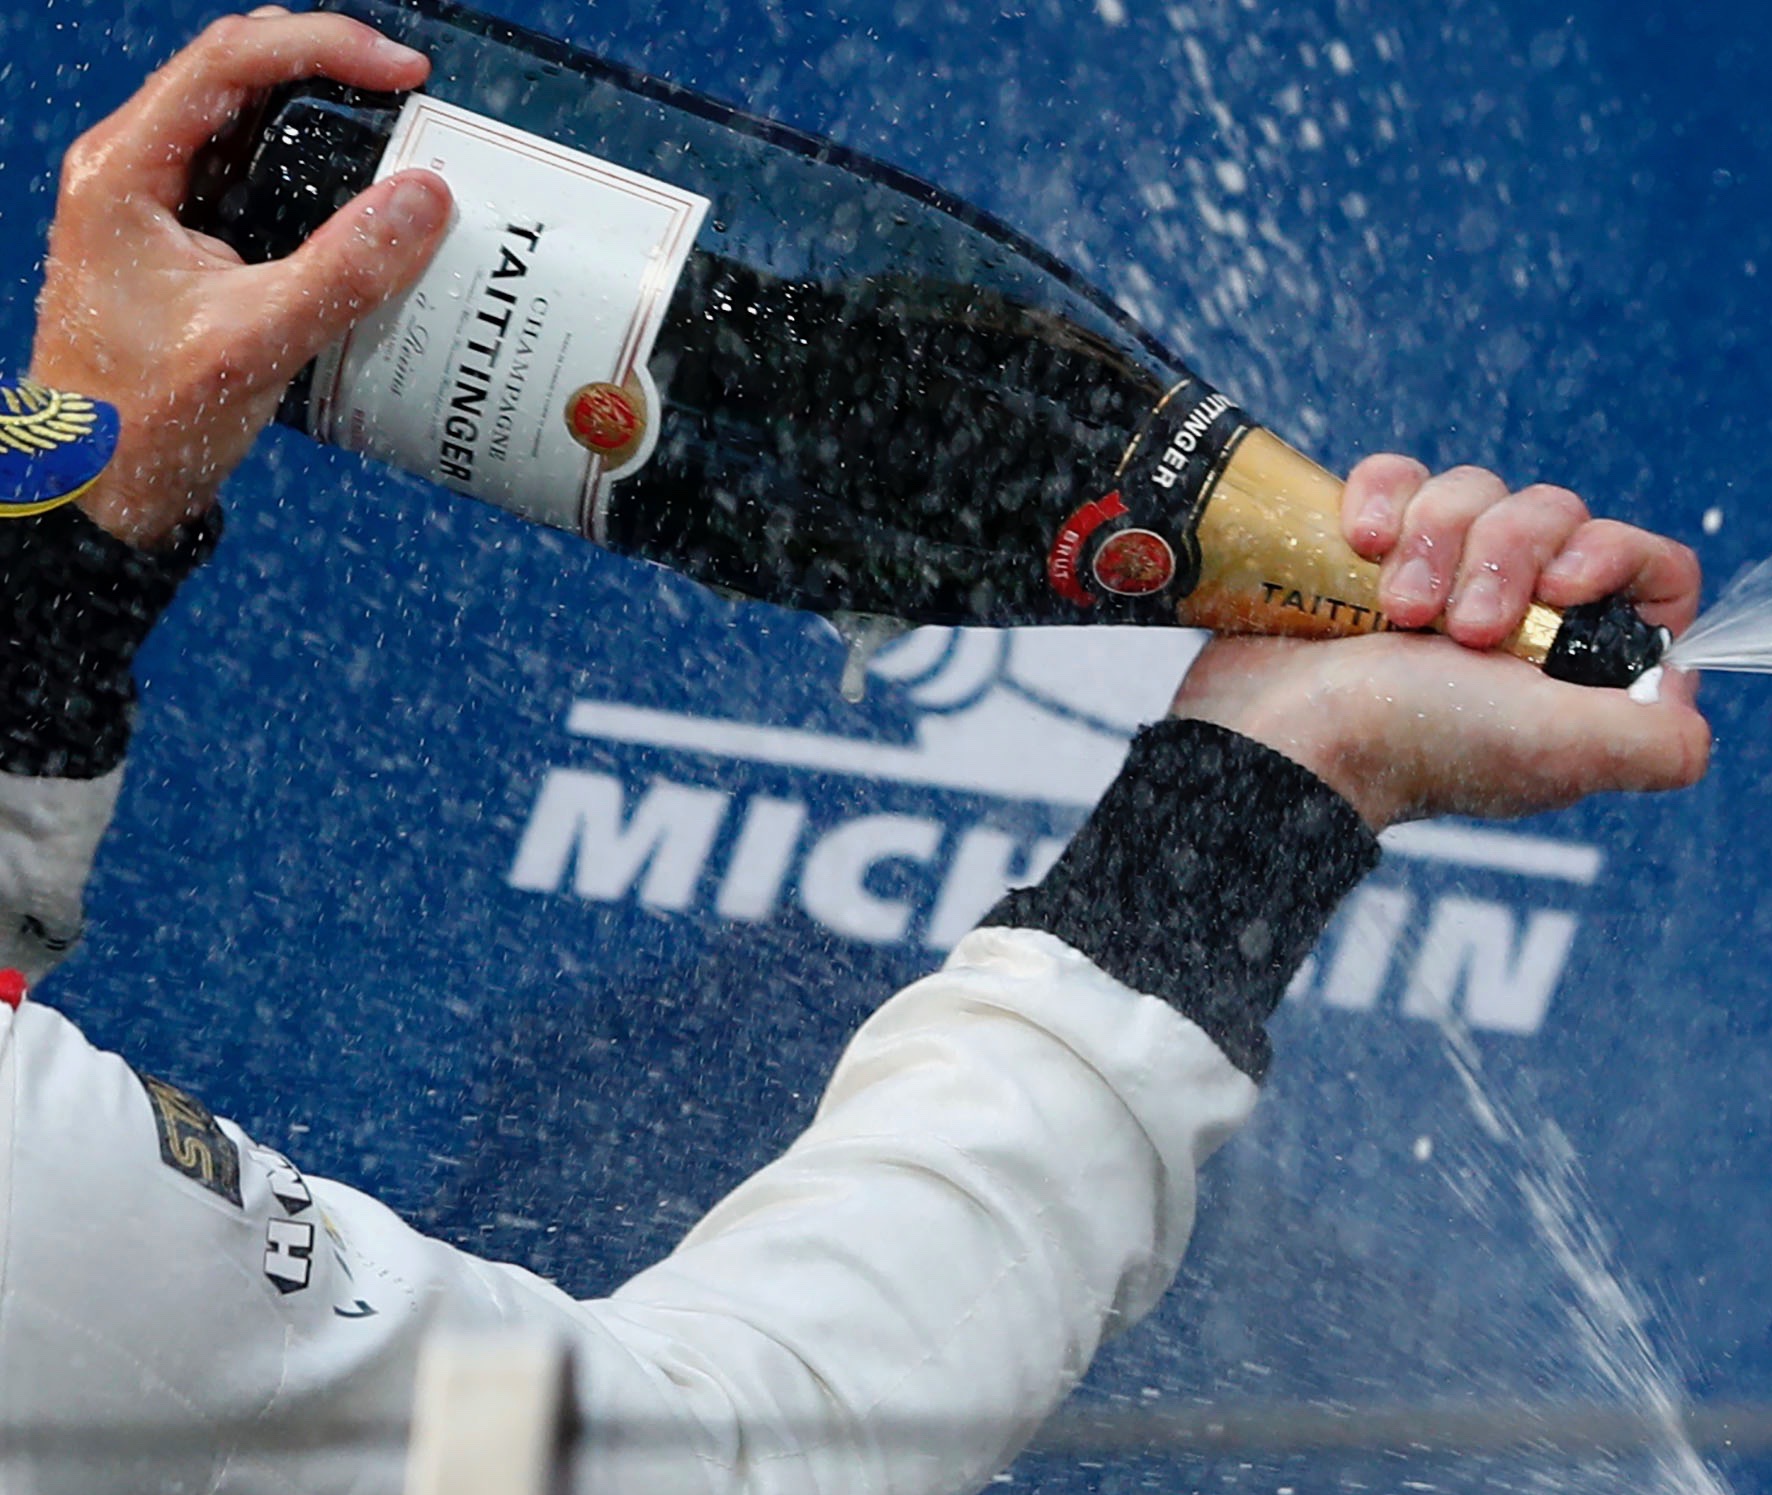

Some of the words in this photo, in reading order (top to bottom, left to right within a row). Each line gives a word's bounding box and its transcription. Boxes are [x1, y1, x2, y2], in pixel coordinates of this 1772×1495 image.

[440, 222, 545, 482] TAITTINGER
[490, 296, 549, 463] CHAMPAGNE
[1262, 581, 1405, 634] TAITTI
[508, 766, 1580, 1037] MICHIN
